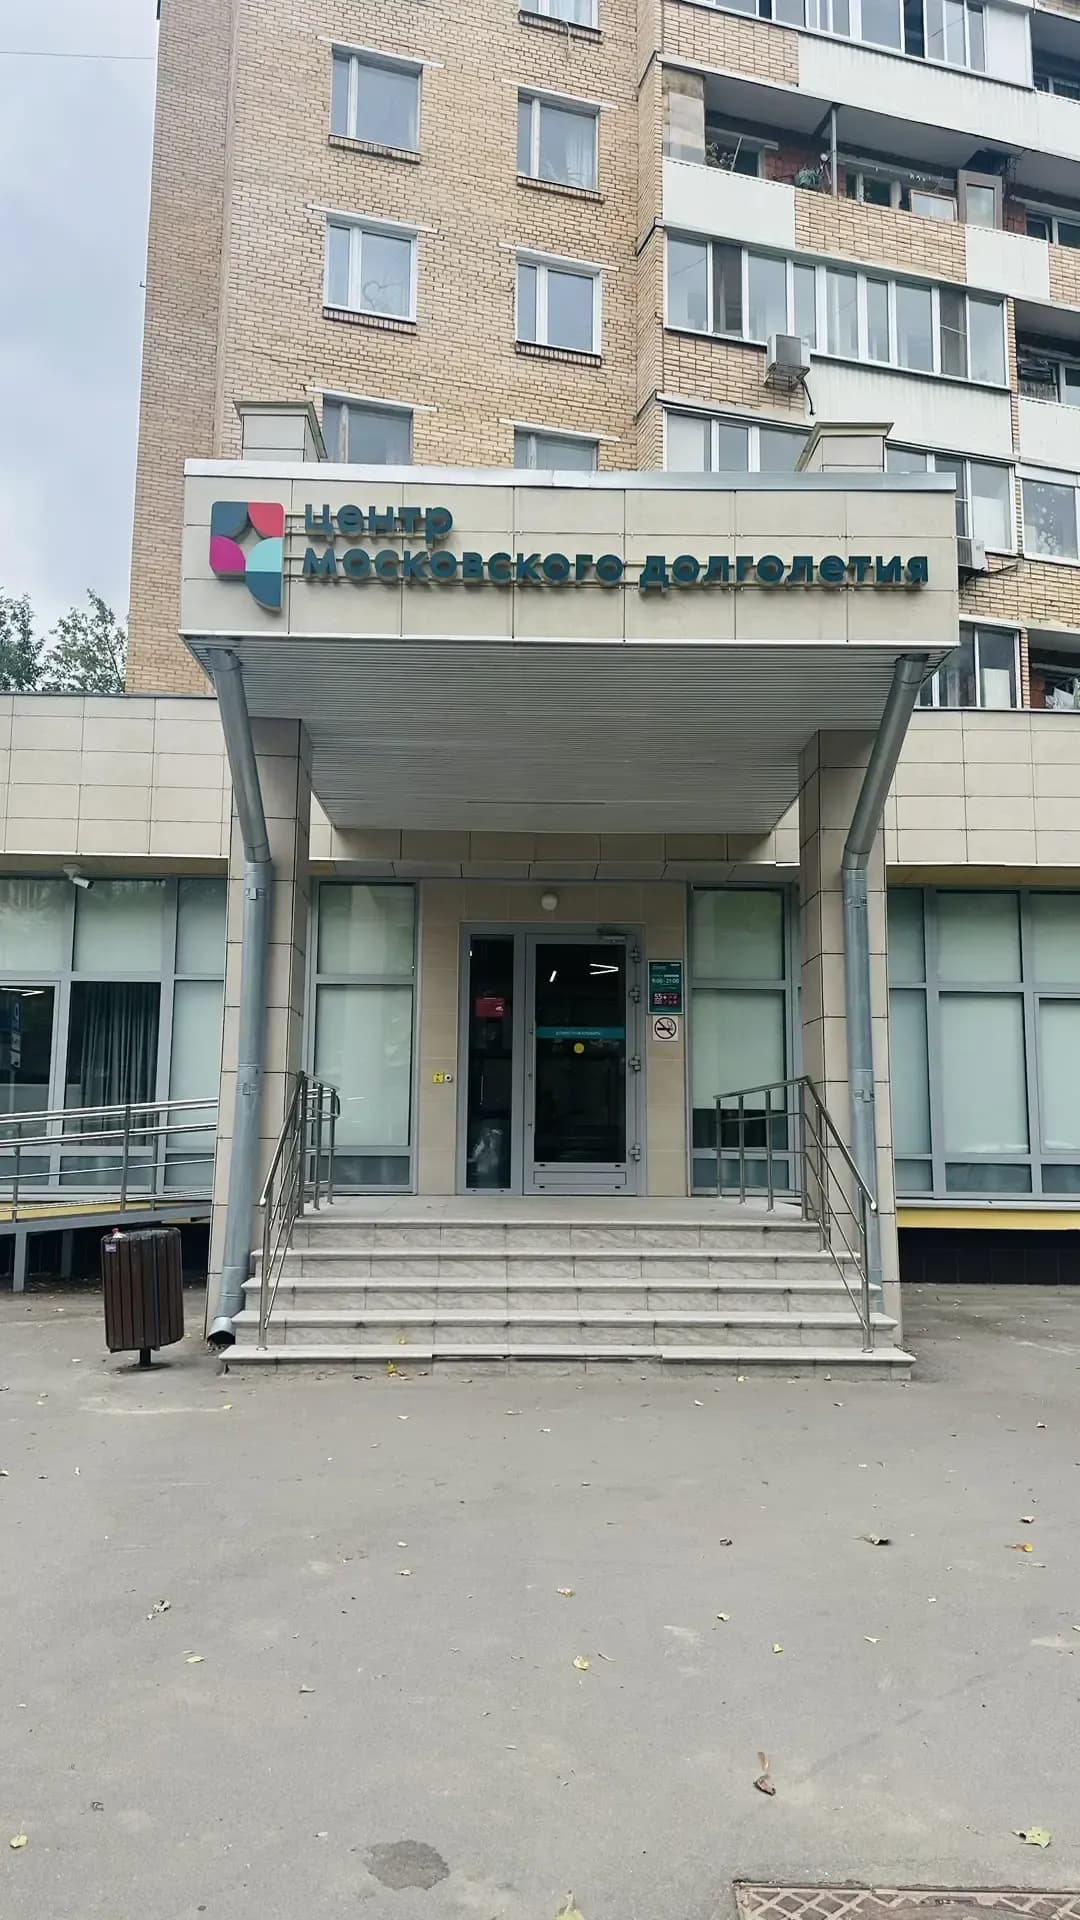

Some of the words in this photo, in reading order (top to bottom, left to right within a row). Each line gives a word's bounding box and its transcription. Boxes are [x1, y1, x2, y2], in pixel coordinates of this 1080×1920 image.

[304, 503, 453, 547] центр
[303, 547, 624, 583] московского
[639, 554, 929, 592] долголетия
